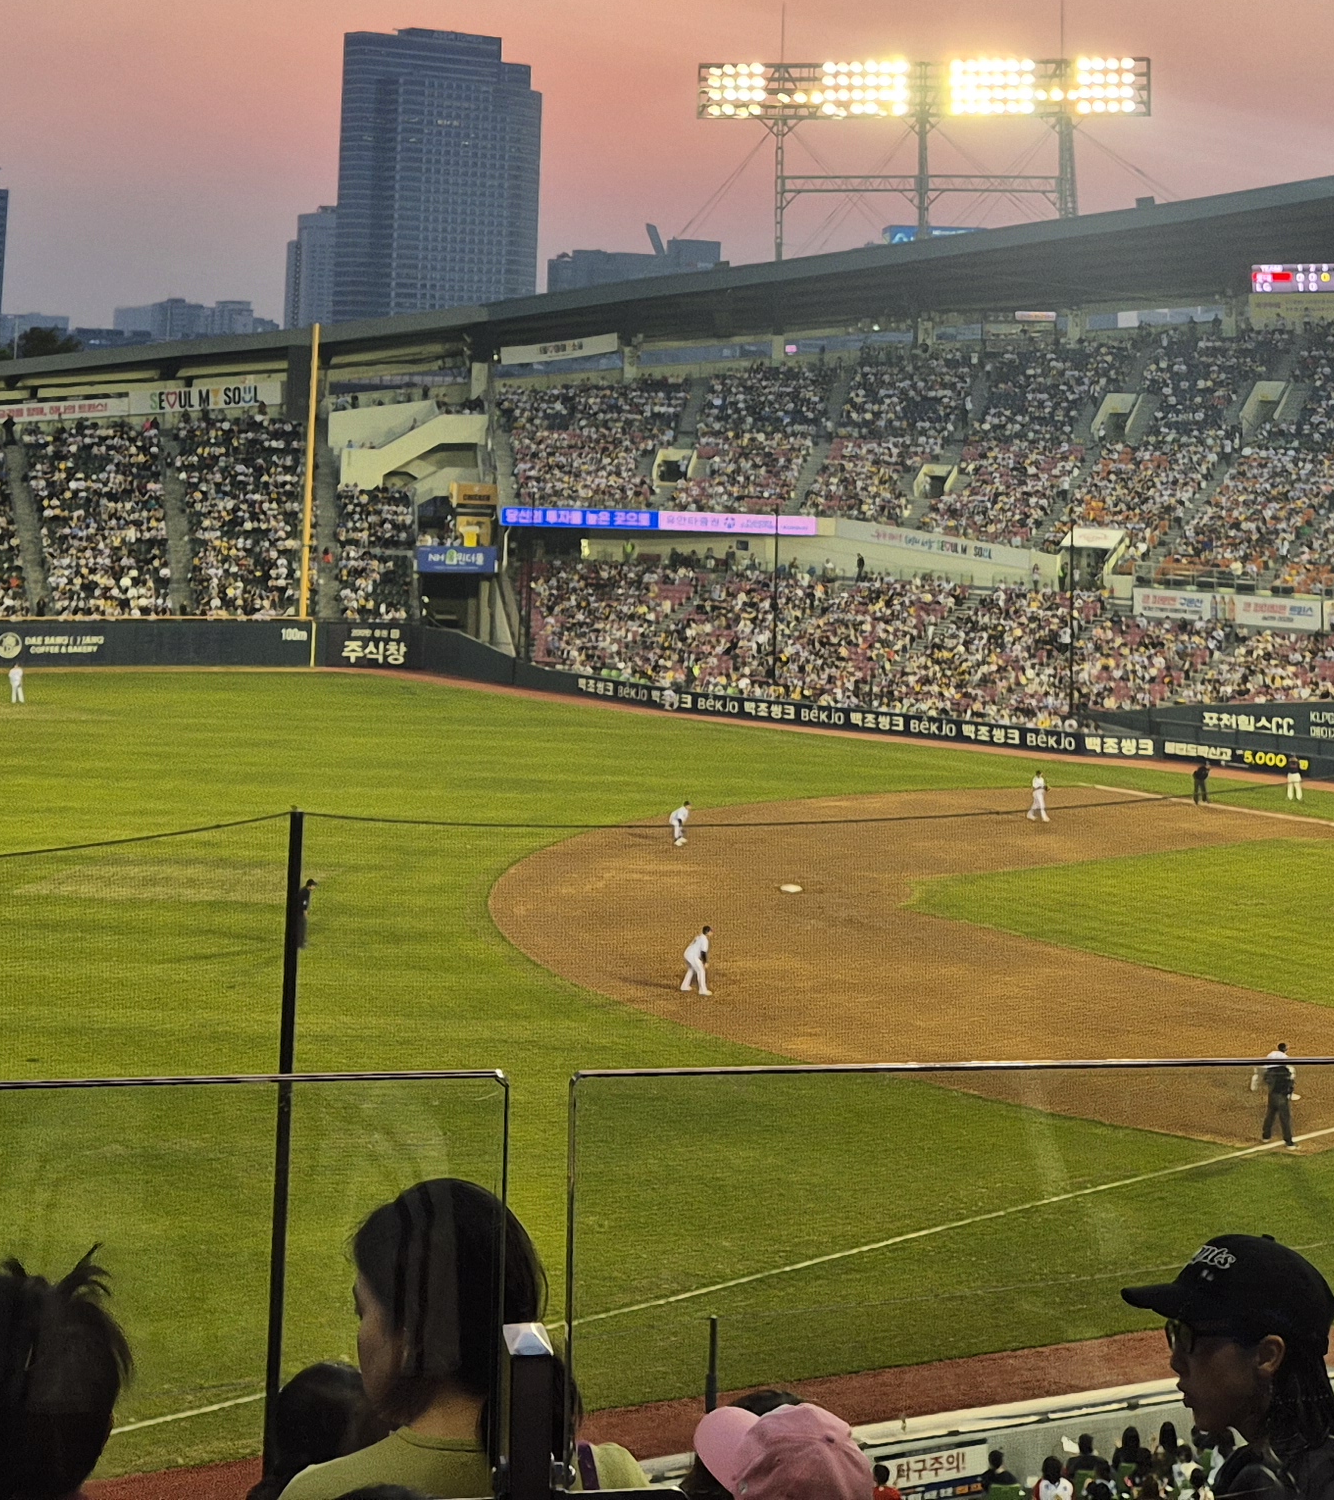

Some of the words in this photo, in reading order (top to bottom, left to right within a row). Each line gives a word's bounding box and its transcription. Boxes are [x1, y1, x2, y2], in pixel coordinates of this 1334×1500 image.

[280, 628, 308, 642] 100m
[341, 640, 408, 665] 주식창
[744, 700, 796, 721] 백조씽크
[849, 711, 905, 732] 백조씽크
[961, 722, 1020, 745] 백조씽크
[1084, 735, 1155, 756] 백조씽크
[1243, 750, 1288, 768] 5,000
